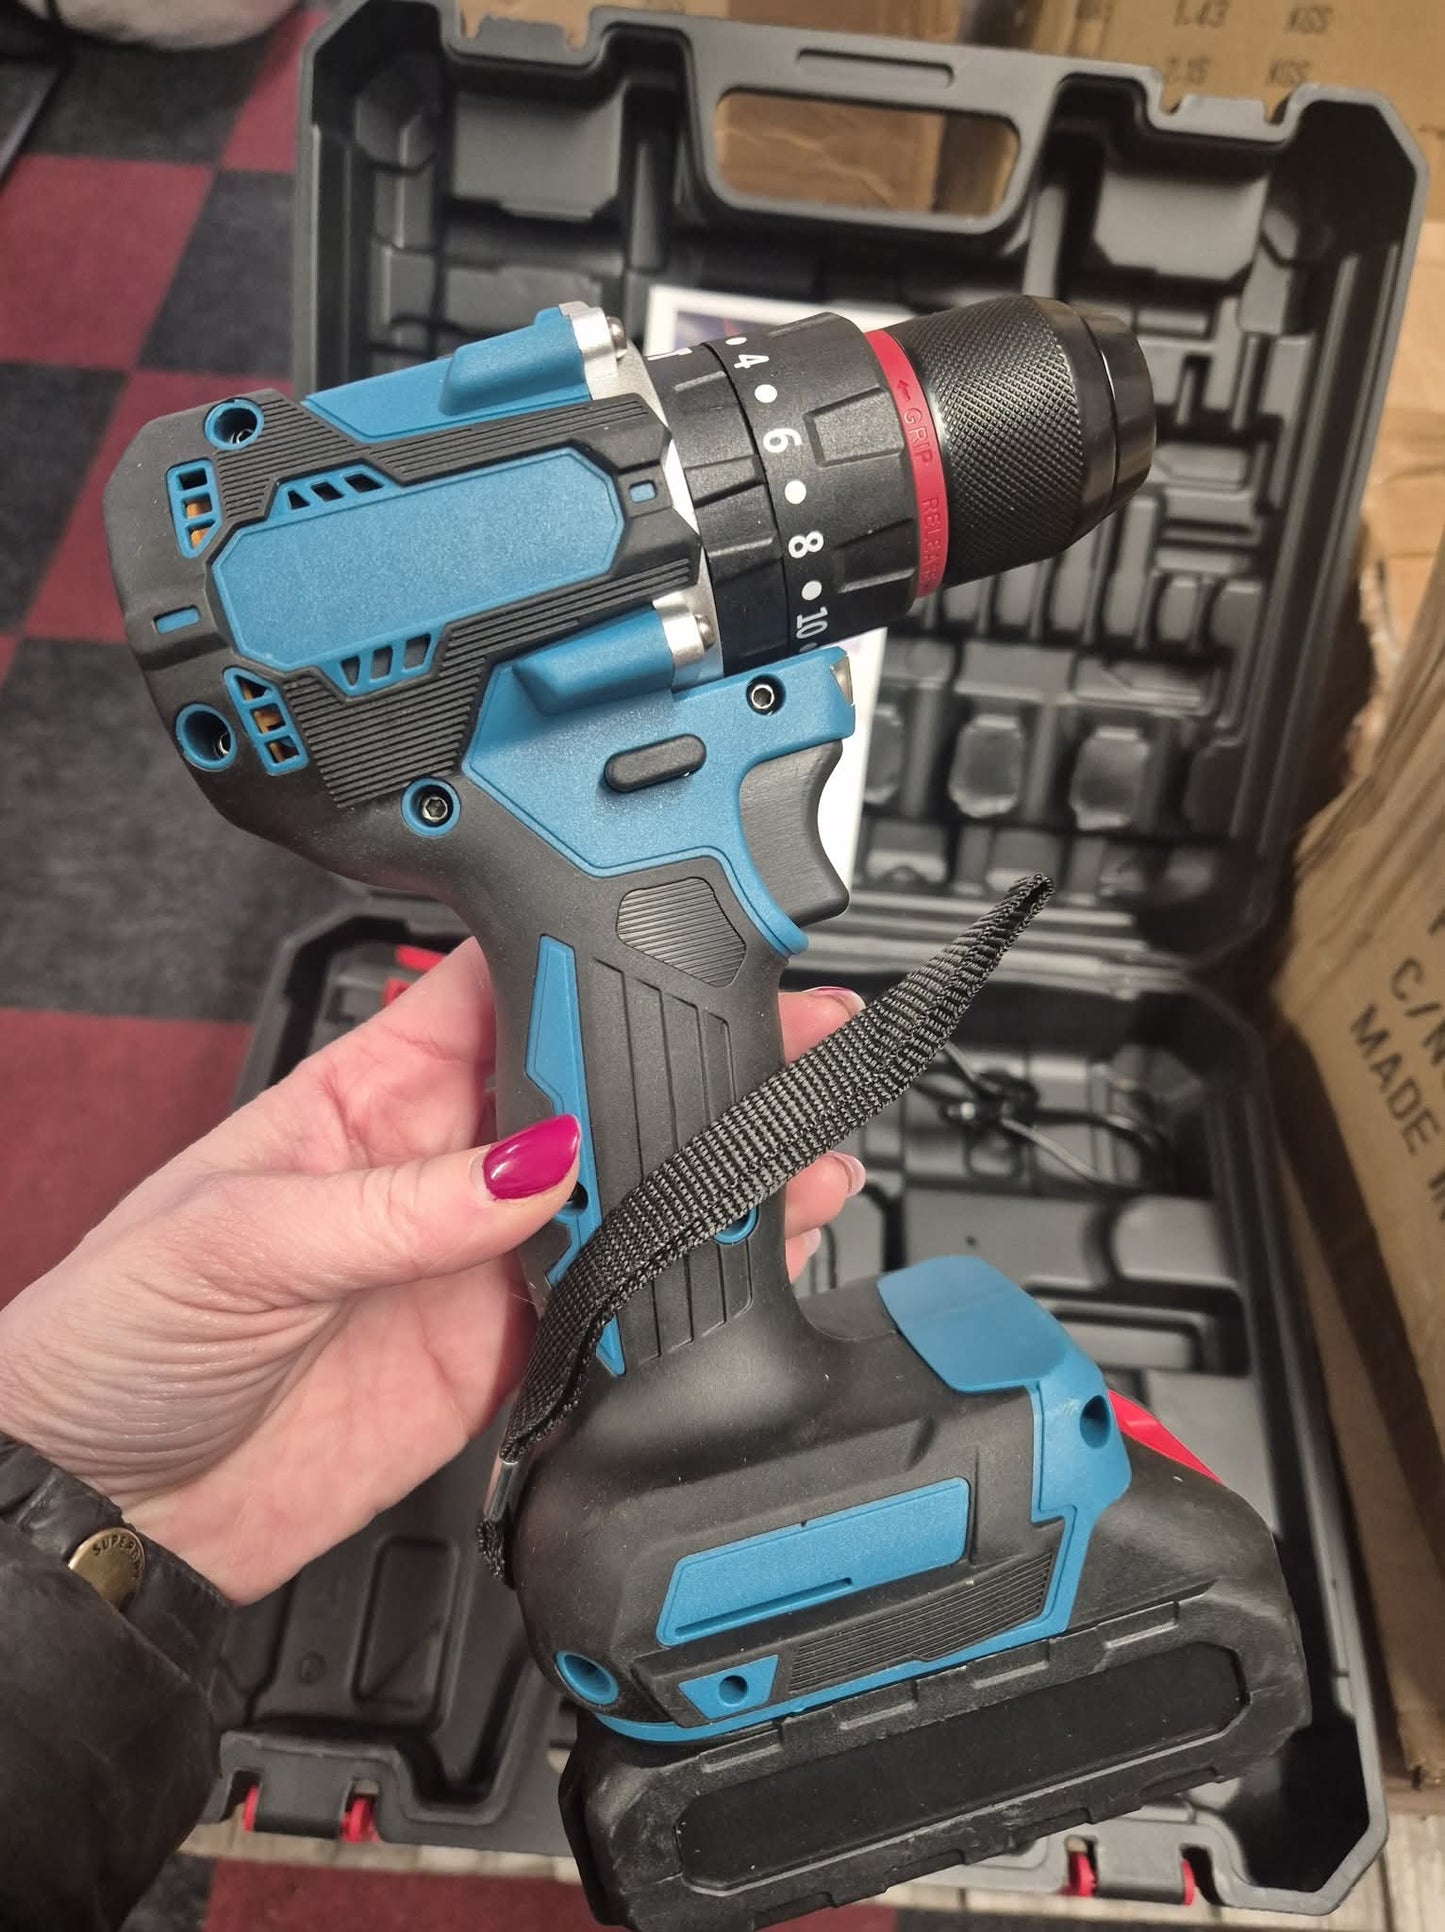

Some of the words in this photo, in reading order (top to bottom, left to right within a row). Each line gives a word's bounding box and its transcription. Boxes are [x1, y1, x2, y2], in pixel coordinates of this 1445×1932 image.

[733, 354, 770, 369] 4
[762, 428, 803, 453] 6
[903, 407, 934, 462] GRIP
[788, 530, 825, 559] 8
[796, 605, 829, 640] 10
[1349, 1003, 1441, 1156] MADE
